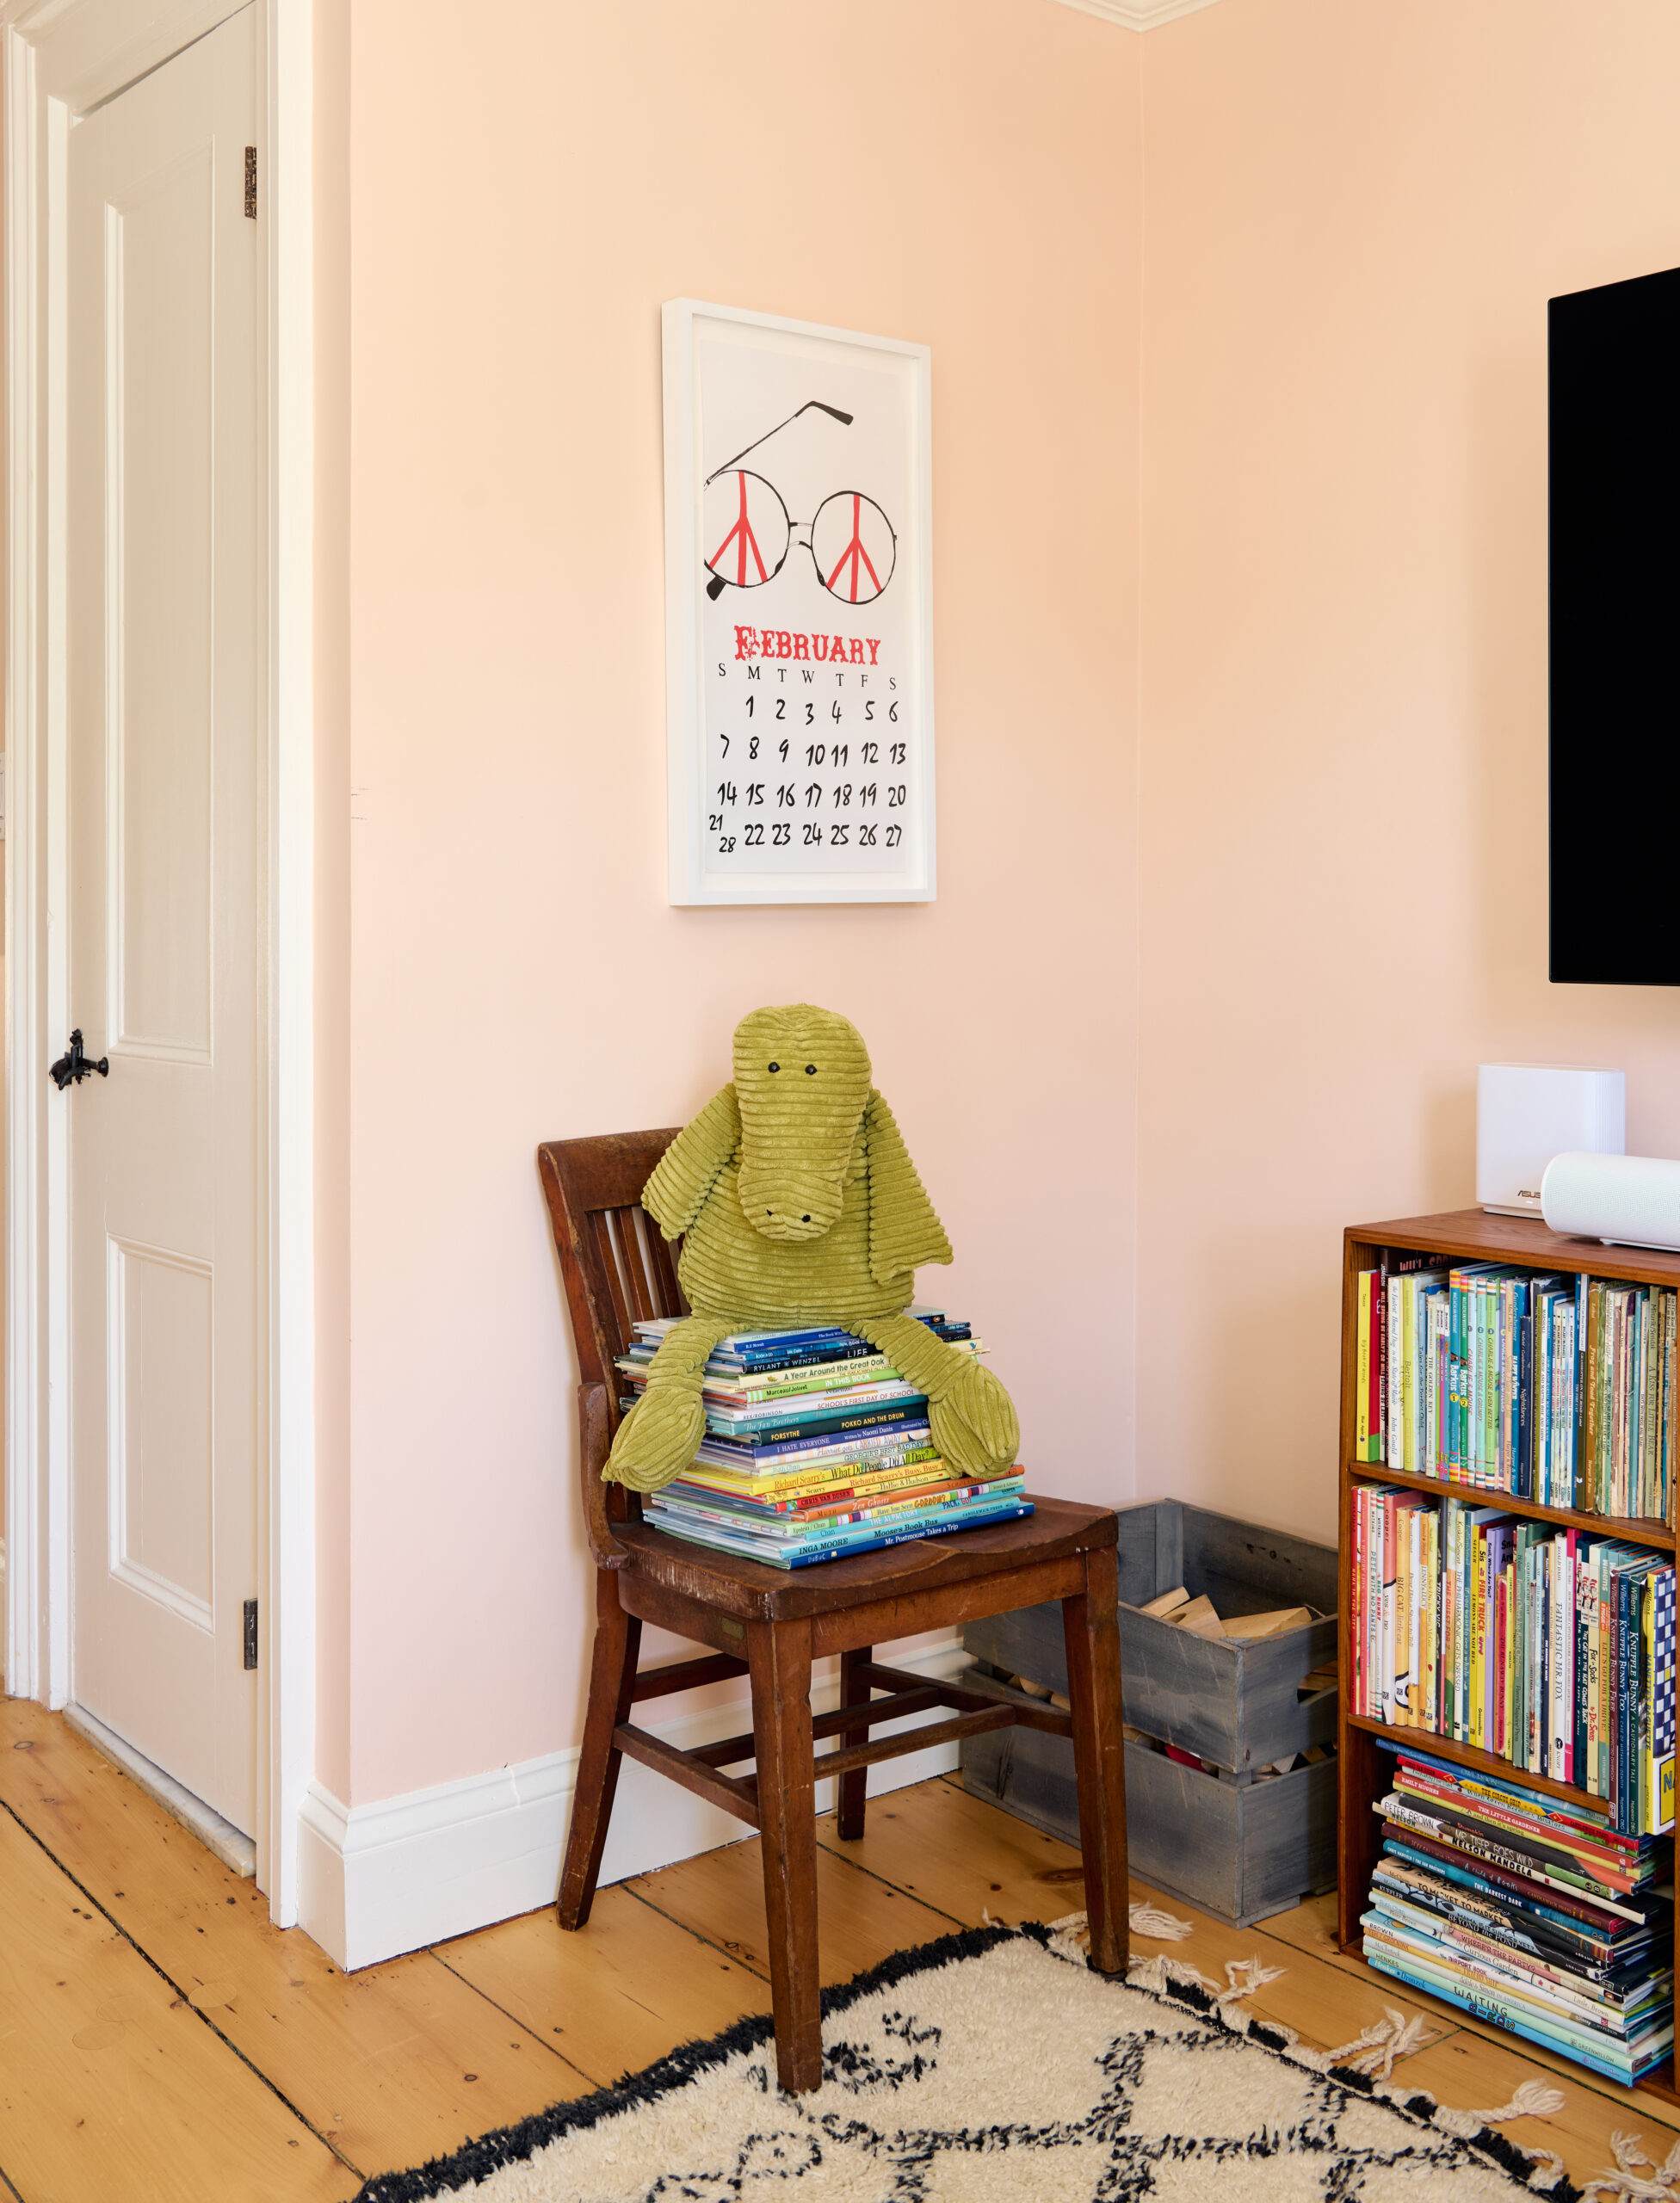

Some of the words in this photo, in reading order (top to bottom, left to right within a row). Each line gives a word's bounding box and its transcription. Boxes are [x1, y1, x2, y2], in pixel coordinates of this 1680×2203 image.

[734, 626, 880, 665] FEBRUARY
[719, 663, 726, 676] S
[748, 666, 761, 680] M
[778, 669, 787, 682] T
[802, 670, 815, 684] W
[836, 674, 844, 687] T
[861, 675, 868, 688] F
[890, 677, 897, 690] S
[746, 695, 754, 718] 1
[776, 699, 786, 719] 2
[806, 703, 815, 725] 3
[832, 700, 843, 725] 4
[865, 701, 875, 720] 5
[889, 701, 899, 722] 6
[720, 734, 730, 759] 7
[750, 737, 760, 760] 8
[779, 739, 789, 763] 9
[806, 744, 825, 768] 10
[831, 744, 849, 768] 11
[862, 743, 879, 764] 12
[890, 744, 906, 764] 13
[718, 781, 738, 806] 14
[746, 783, 765, 806] 15
[777, 783, 795, 807] 16
[806, 783, 822, 807] 17
[833, 784, 852, 809] 18
[860, 783, 877, 808] 19
[888, 785, 906, 807] 20
[709, 814, 724, 831] 21
[744, 824, 765, 845] 22
[772, 824, 791, 845] 23
[803, 823, 823, 847] 24
[831, 824, 850, 845] 25
[859, 824, 879, 846] 26
[886, 824, 903, 847] 27
[720, 836, 737, 853] 28
[753, 1362, 781, 1373] RYLANT
[792, 1357, 821, 1367] WENZEL
[847, 1348, 868, 1358] LIFE
[791, 1370, 806, 1379] Year
[808, 1366, 835, 1377] Around
[849, 1361, 869, 1372] Great
[871, 1358, 885, 1368] Oak
[834, 1377, 851, 1385] THIS
[853, 1373, 870, 1384] BOOK
[818, 1399, 848, 1410] SCHOOL'S
[849, 1397, 868, 1405] FIRST
[890, 1390, 914, 1400] SCHOOL
[842, 1419, 862, 1429] POKKO
[863, 1416, 876, 1425] AND
[888, 1412, 905, 1421] DRUM
[771, 1429, 800, 1441] FORSYTHE
[800, 1438, 830, 1449] EVERYONE
[844, 1449, 879, 1461] GEORGIE'S
[880, 1447, 895, 1455] BEST
[897, 1443, 910, 1453] BAD
[912, 1441, 924, 1450] DAY
[831, 1466, 852, 1479] What
[853, 1464, 863, 1475] Do
[864, 1460, 887, 1473] People
[889, 1457, 900, 1469] Do
[911, 1450, 930, 1463] Day?
[775, 1477, 799, 1490] Richard
[800, 1472, 825, 1487] Scarry's
[850, 1476, 875, 1487] Richard
[877, 1470, 904, 1482] Scarry's
[836, 1491, 850, 1501] DUSEN
[874, 1527, 903, 1539] Moose's
[904, 1522, 923, 1533] Book
[924, 1519, 938, 1528] Bus
[885, 1537, 893, 1546] Mr.
[895, 1531, 925, 1543] Postmouse
[926, 1527, 942, 1537] Takes
[948, 1523, 959, 1533] Trip
[799, 1545, 818, 1554] INGA
[820, 1538, 849, 1551] MOORE
[1630, 1632, 1639, 1677] KNUFFLE
[1629, 1680, 1638, 1714] BUNNY
[1402, 1777, 1418, 1786] EMILY
[1418, 1783, 1439, 1795] HUGHES
[1385, 1801, 1407, 1817] PETER
[1408, 1809, 1435, 1830] BROWN
[1478, 1805, 1490, 1814] THE
[1491, 1810, 1511, 1822] LITTLE
[1512, 1818, 1541, 1834] GARDENER
[1452, 1837, 1485, 1857] NELSON
[1490, 1854, 1532, 1878] MANDELA
[1470, 1835, 1490, 1850] TIGER
[1493, 1845, 1514, 1861] GOES
[1418, 1883, 1429, 1892] TO
[1430, 1886, 1459, 1904] MARKET
[1461, 1901, 1472, 1910] TO
[1473, 1906, 1504, 1924] MARKET
[1474, 1882, 1484, 1891] THE
[1485, 1885, 1506, 1900] DARKEST
[1508, 1896, 1522, 1908] DARK
[1369, 1923, 1393, 1937] BROWN
[1376, 1953, 1399, 1968] HENKES
[1461, 1935, 1492, 1953] WHERE'S
[1493, 1948, 1506, 1959] THE
[1508, 1954, 1535, 1972] PARTY?
[1464, 1943, 1492, 1962] Curious
[1492, 1957, 1518, 1976] Garden
[1455, 1986, 1508, 2017] WAITING
[1468, 2002, 1515, 2031] BIRDS
